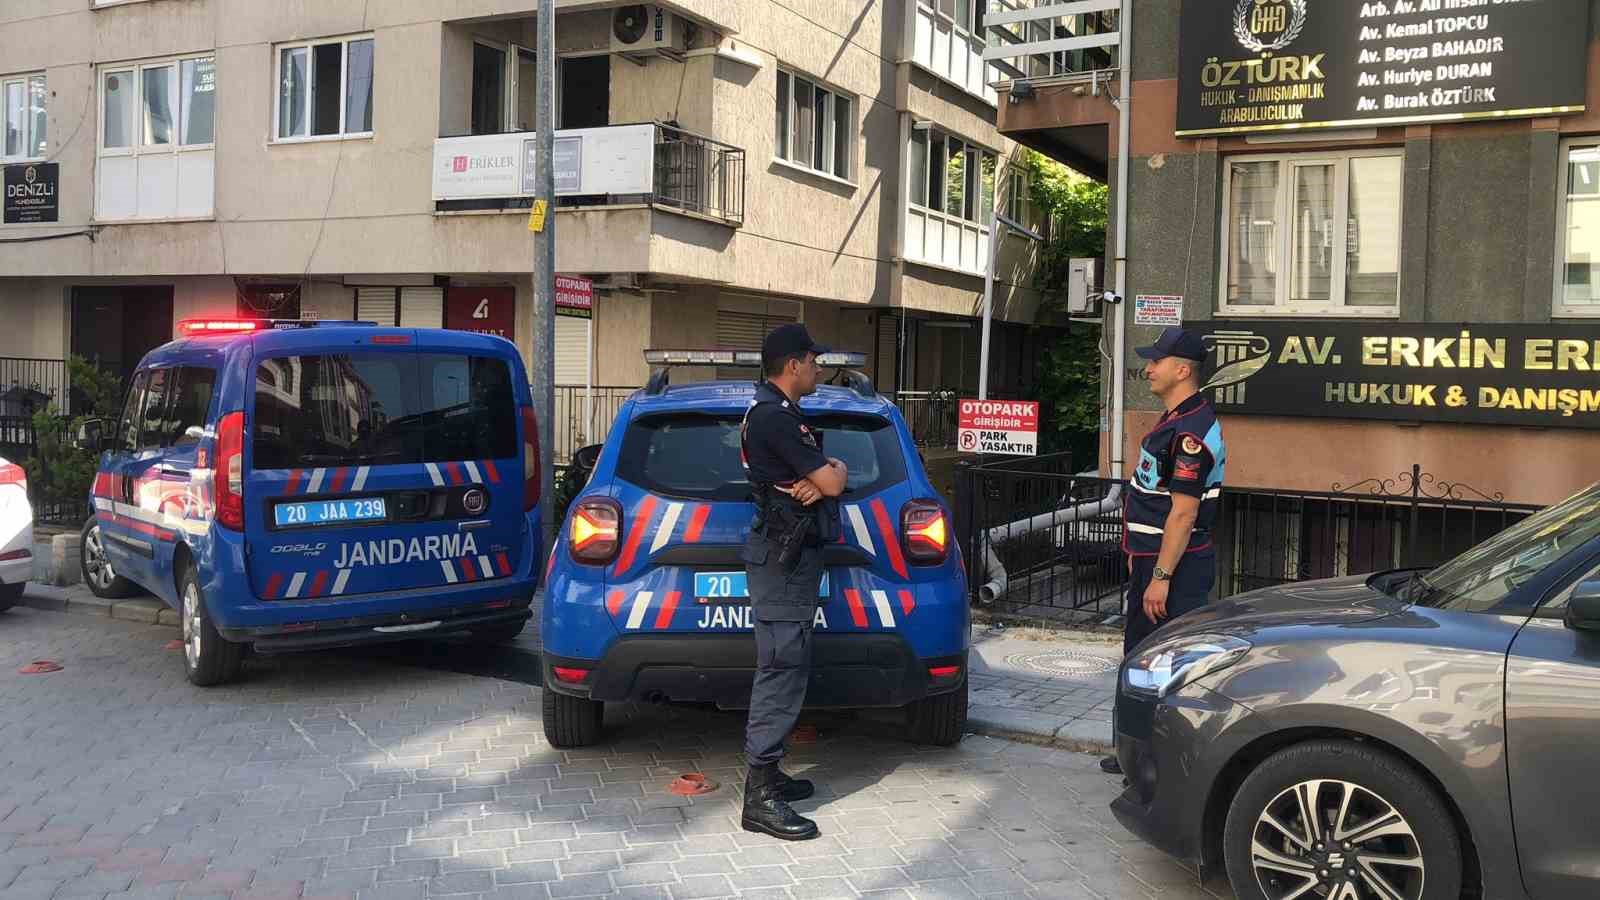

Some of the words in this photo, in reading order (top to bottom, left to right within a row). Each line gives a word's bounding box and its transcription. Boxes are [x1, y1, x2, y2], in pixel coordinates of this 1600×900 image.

[1394, 0, 1416, 14] Av.
[1359, 26, 1382, 41] Av.
[1386, 20, 1433, 39] Kemal
[1436, 14, 1489, 34] TOPCU
[1358, 48, 1381, 64] Av.
[1385, 44, 1429, 63] Beyza
[1432, 37, 1504, 58] BAHADIR
[1201, 53, 1326, 87] ÖZTÜRK
[1357, 71, 1380, 87] Av.
[1384, 67, 1433, 86] Huriye
[1436, 62, 1492, 80] DURAN
[1201, 90, 1236, 106] HUKUK
[1248, 83, 1325, 103] DANIŞMANLIK
[1356, 95, 1379, 111] Av.
[1383, 92, 1429, 109] Burak
[1431, 87, 1496, 106] ÖZTÜRK
[1219, 103, 1304, 123] ARABULUCULUK
[556, 278, 591, 291] OTOPARK
[1277, 336, 1342, 365] AV.
[1362, 329, 1506, 369] ERKİN
[1325, 382, 1437, 407] HUKUK
[1445, 385, 1468, 407] &
[962, 402, 1034, 417] OTOPARK
[973, 416, 1021, 429] GİRİŞİDİR
[980, 431, 1008, 441] PARK
[980, 442, 1033, 453] YASAKTIR
[287, 505, 307, 523] 20
[320, 502, 348, 520] JAA
[355, 500, 383, 517] 239
[333, 532, 478, 569] JANDARMA
[708, 576, 731, 597] 20
